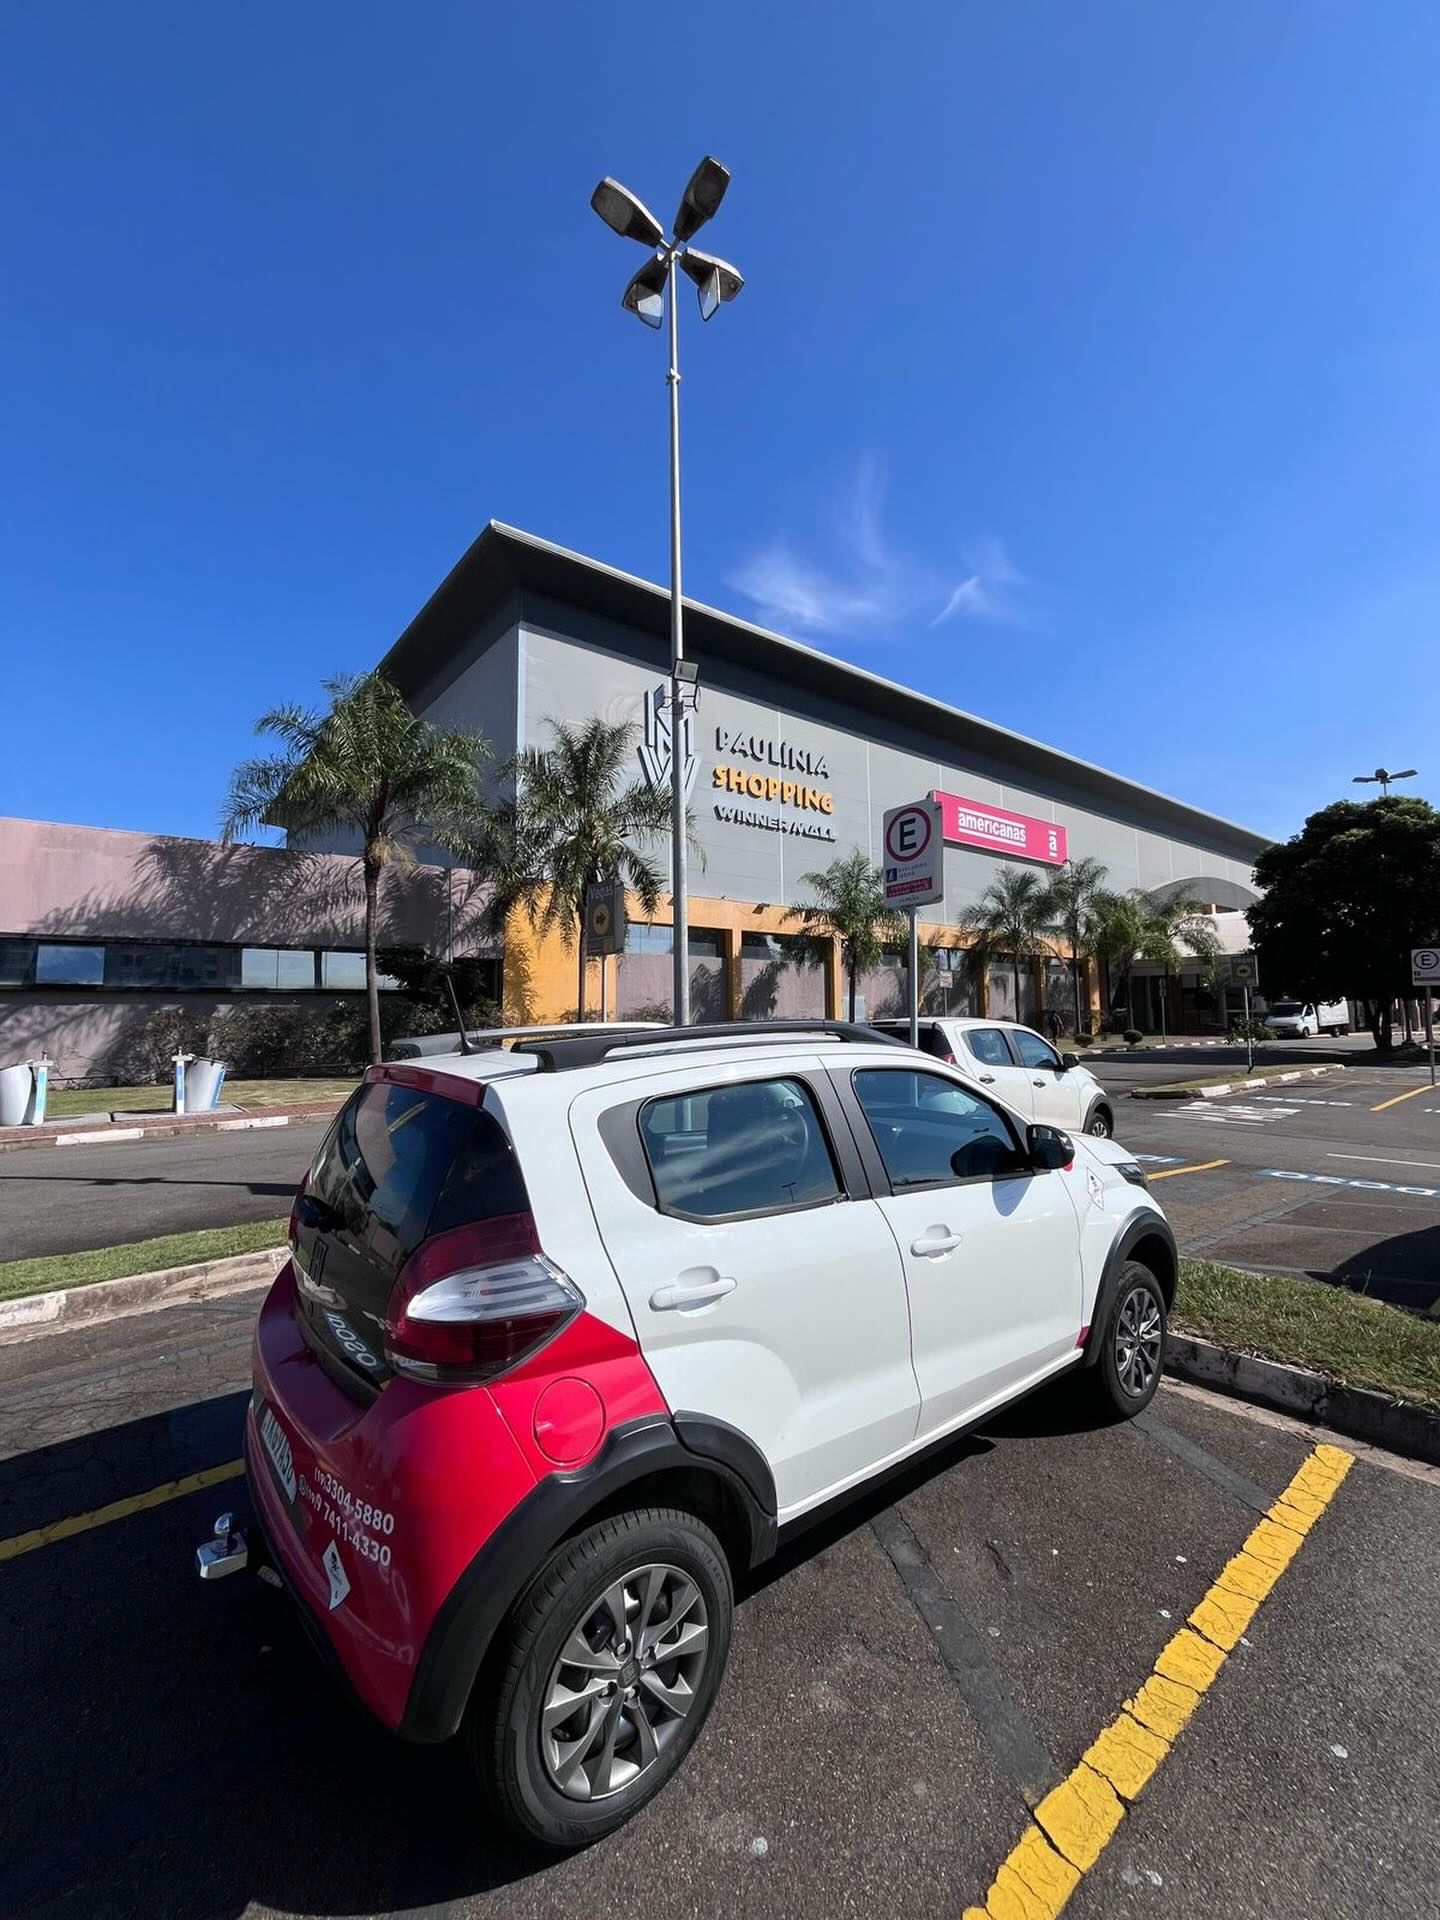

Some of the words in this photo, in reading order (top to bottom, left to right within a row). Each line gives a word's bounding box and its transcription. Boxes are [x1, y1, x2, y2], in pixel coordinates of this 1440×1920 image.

[712, 765, 834, 815] SHOPPING
[713, 804, 788, 834] WINNER
[788, 819, 836, 842] MALL
[899, 817, 917, 852] E
[958, 812, 1026, 843] americanas
[1420, 954, 1432, 966] E
[326, 1311, 378, 1367] IDOSO
[323, 1503, 392, 1567] 7411-4330
